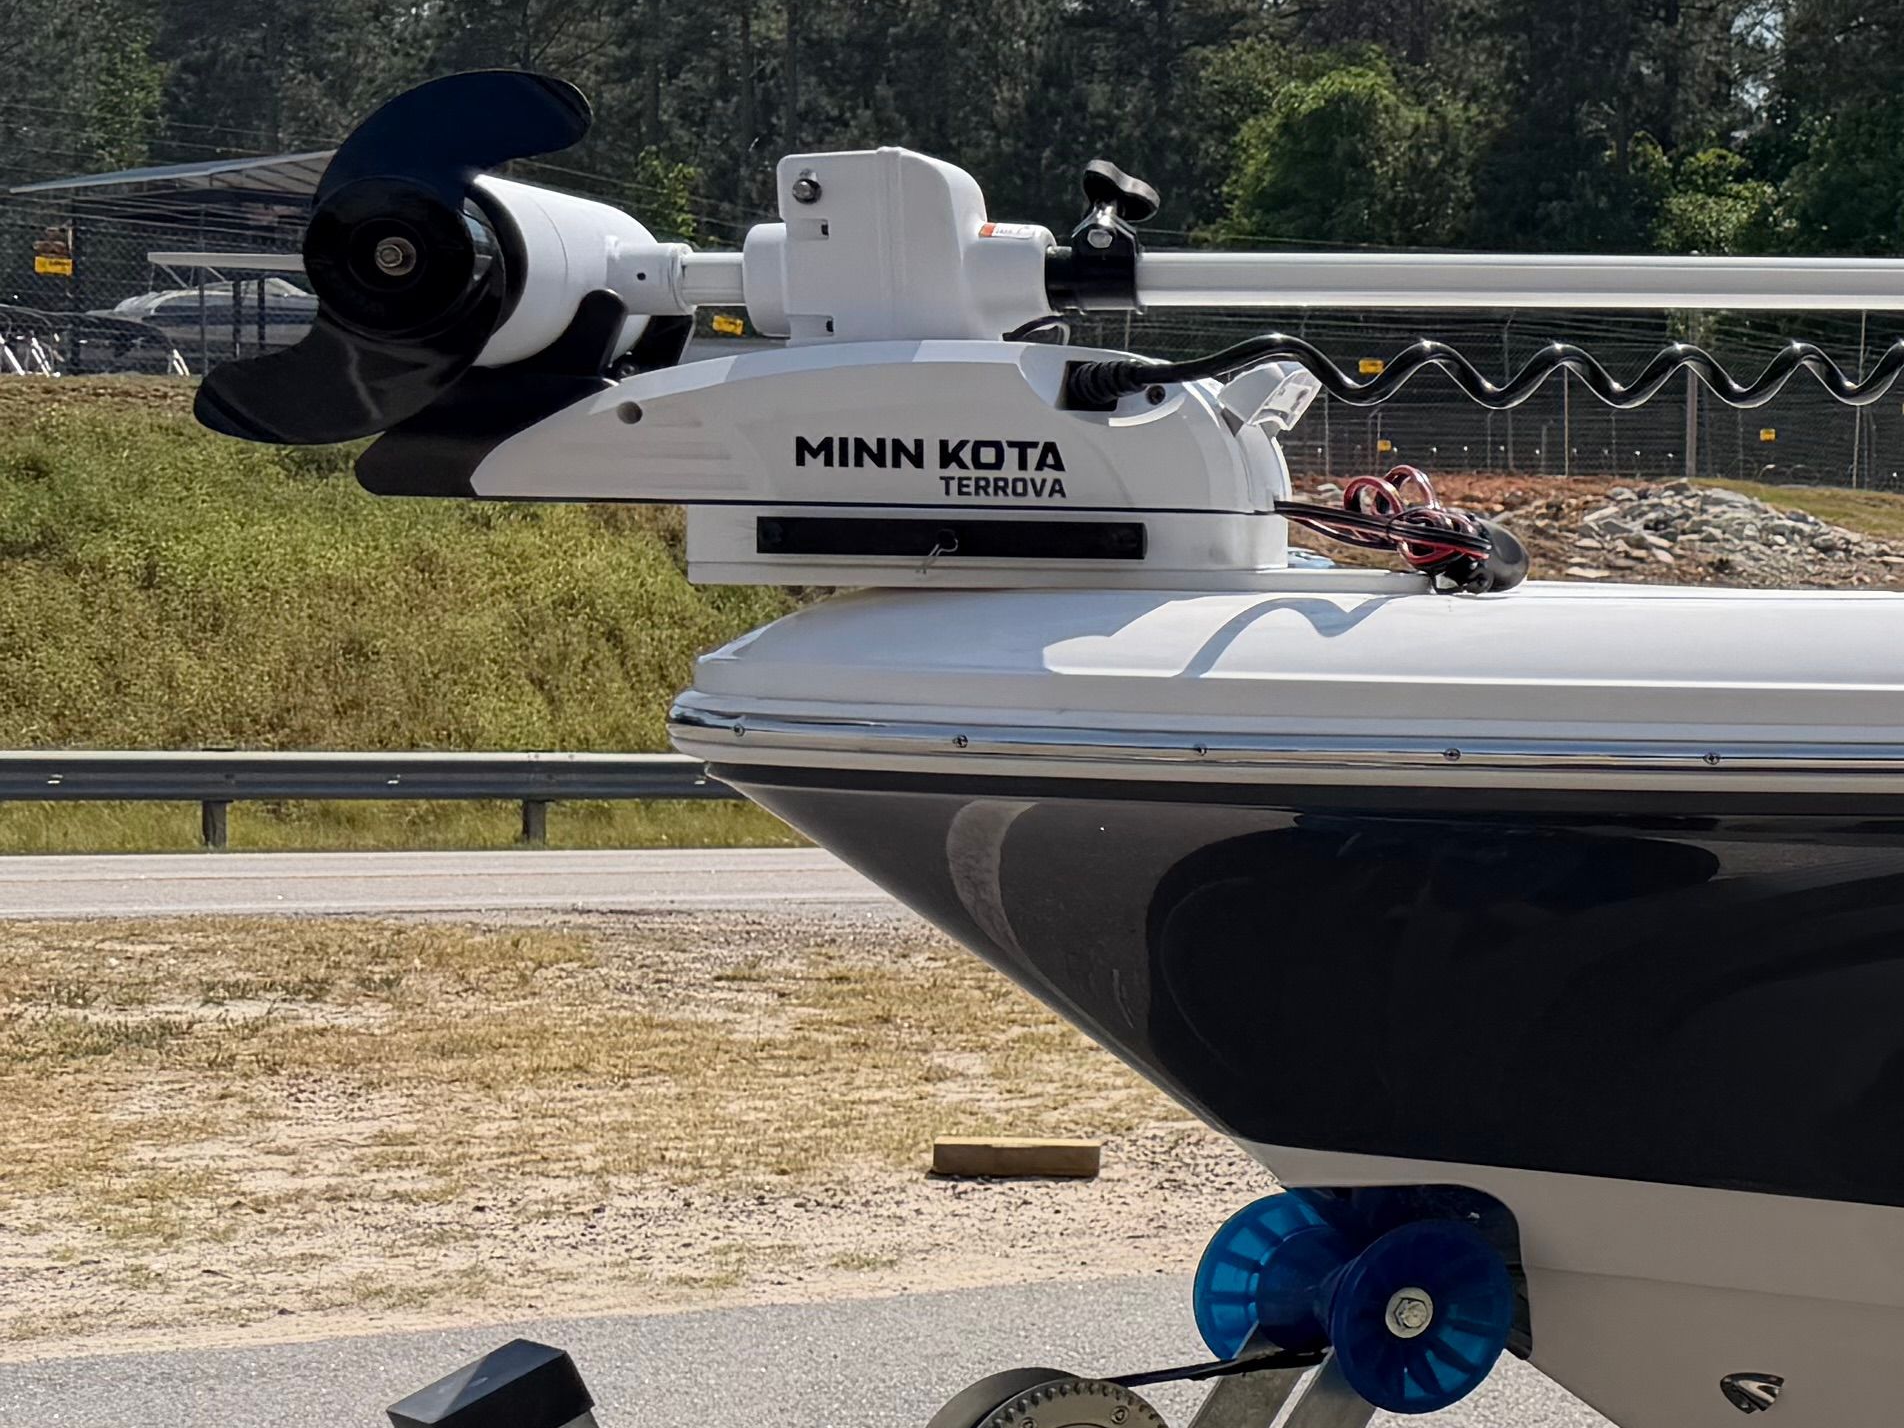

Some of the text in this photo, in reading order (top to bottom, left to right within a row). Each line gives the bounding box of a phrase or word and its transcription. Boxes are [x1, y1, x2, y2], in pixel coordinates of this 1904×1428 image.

[795, 436, 1066, 472] MINN KOTA
[938, 476, 1067, 499] TERROVA
